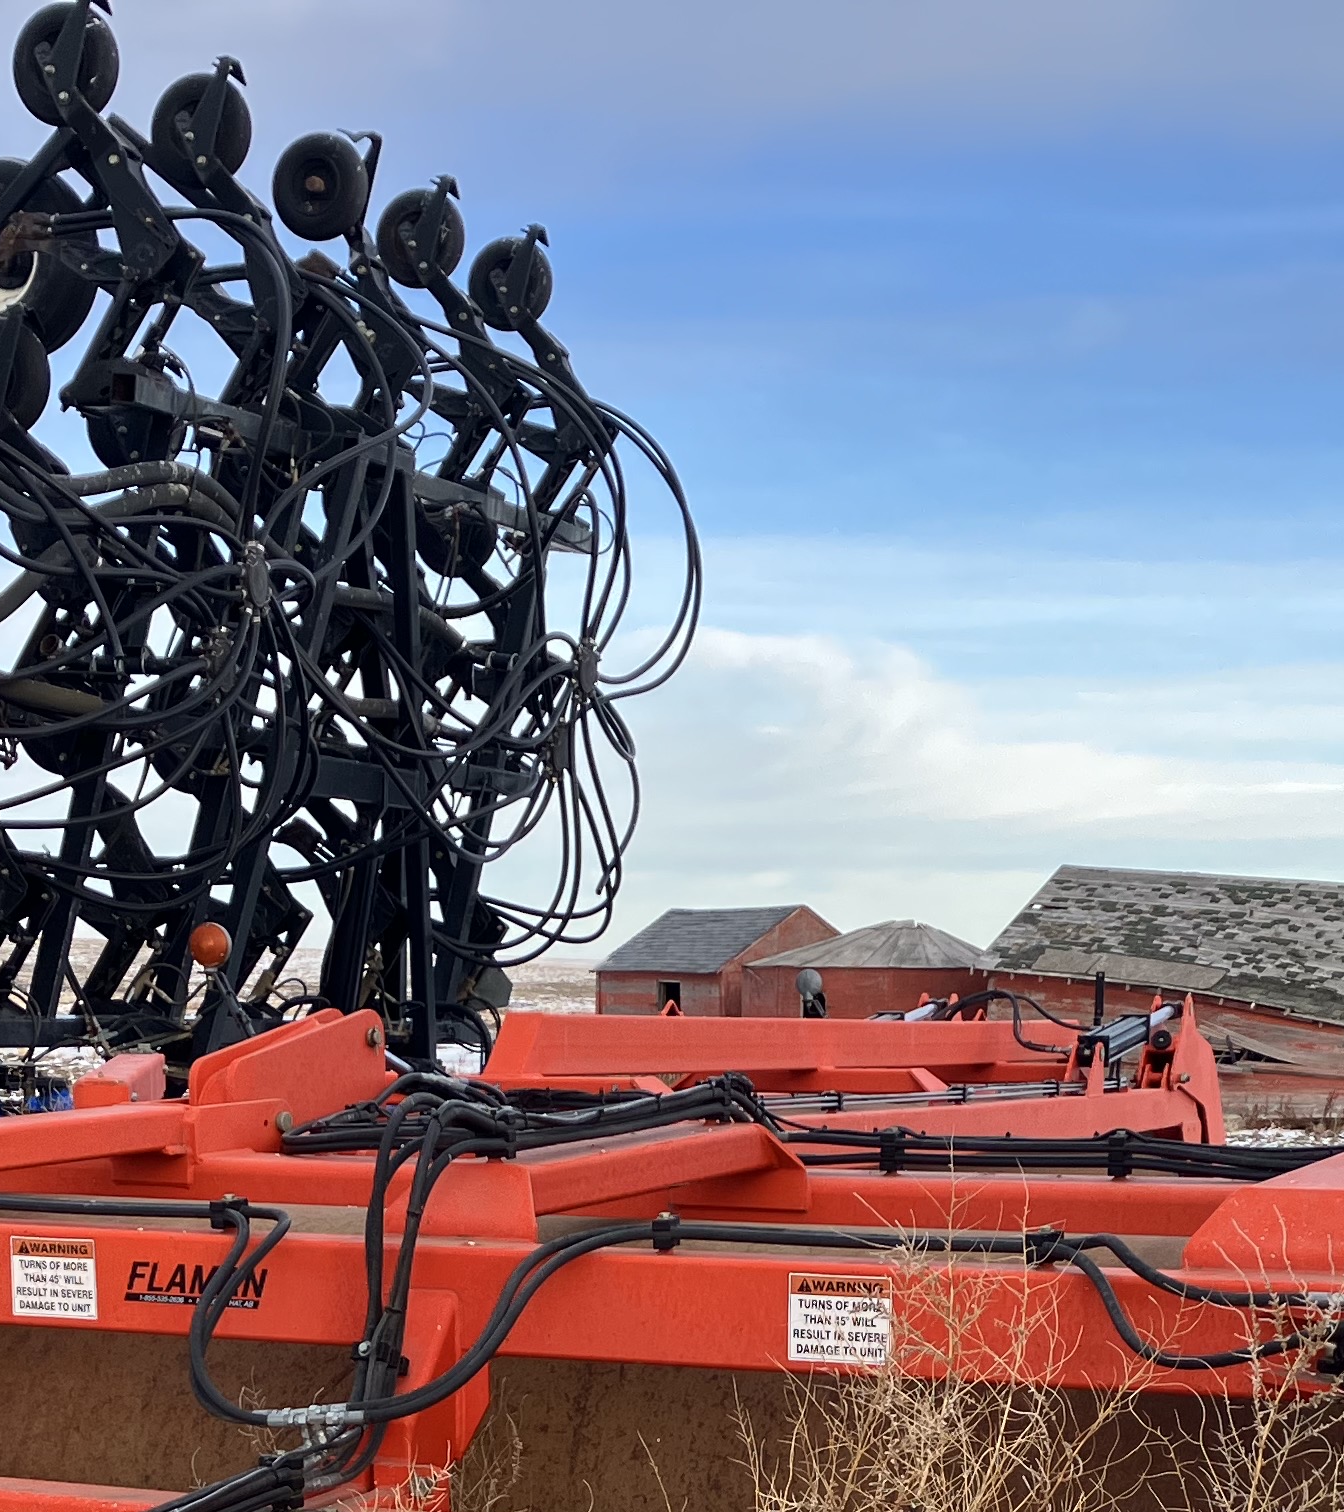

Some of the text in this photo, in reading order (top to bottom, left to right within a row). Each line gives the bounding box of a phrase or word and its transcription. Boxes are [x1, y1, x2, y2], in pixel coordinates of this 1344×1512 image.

[29, 1242, 88, 1254] WARNING
[19, 1259, 88, 1271] TURNS OF MORE
[24, 1273, 47, 1283] THAN
[64, 1275, 84, 1285] WILL
[127, 1261, 268, 1298] FLAMN
[16, 1286, 93, 1299] RESULT IN SEVERE
[812, 1280, 884, 1294] WARNING
[19, 1300, 91, 1313] DAMAGE TO UNIT
[798, 1299, 833, 1310] TURNS
[835, 1300, 849, 1311] OF
[803, 1314, 831, 1325] THAN
[851, 1316, 877, 1328] WILL
[793, 1328, 887, 1343] RESULT IN SEVERE
[796, 1343, 886, 1358] DAMAGE TO UNIT
